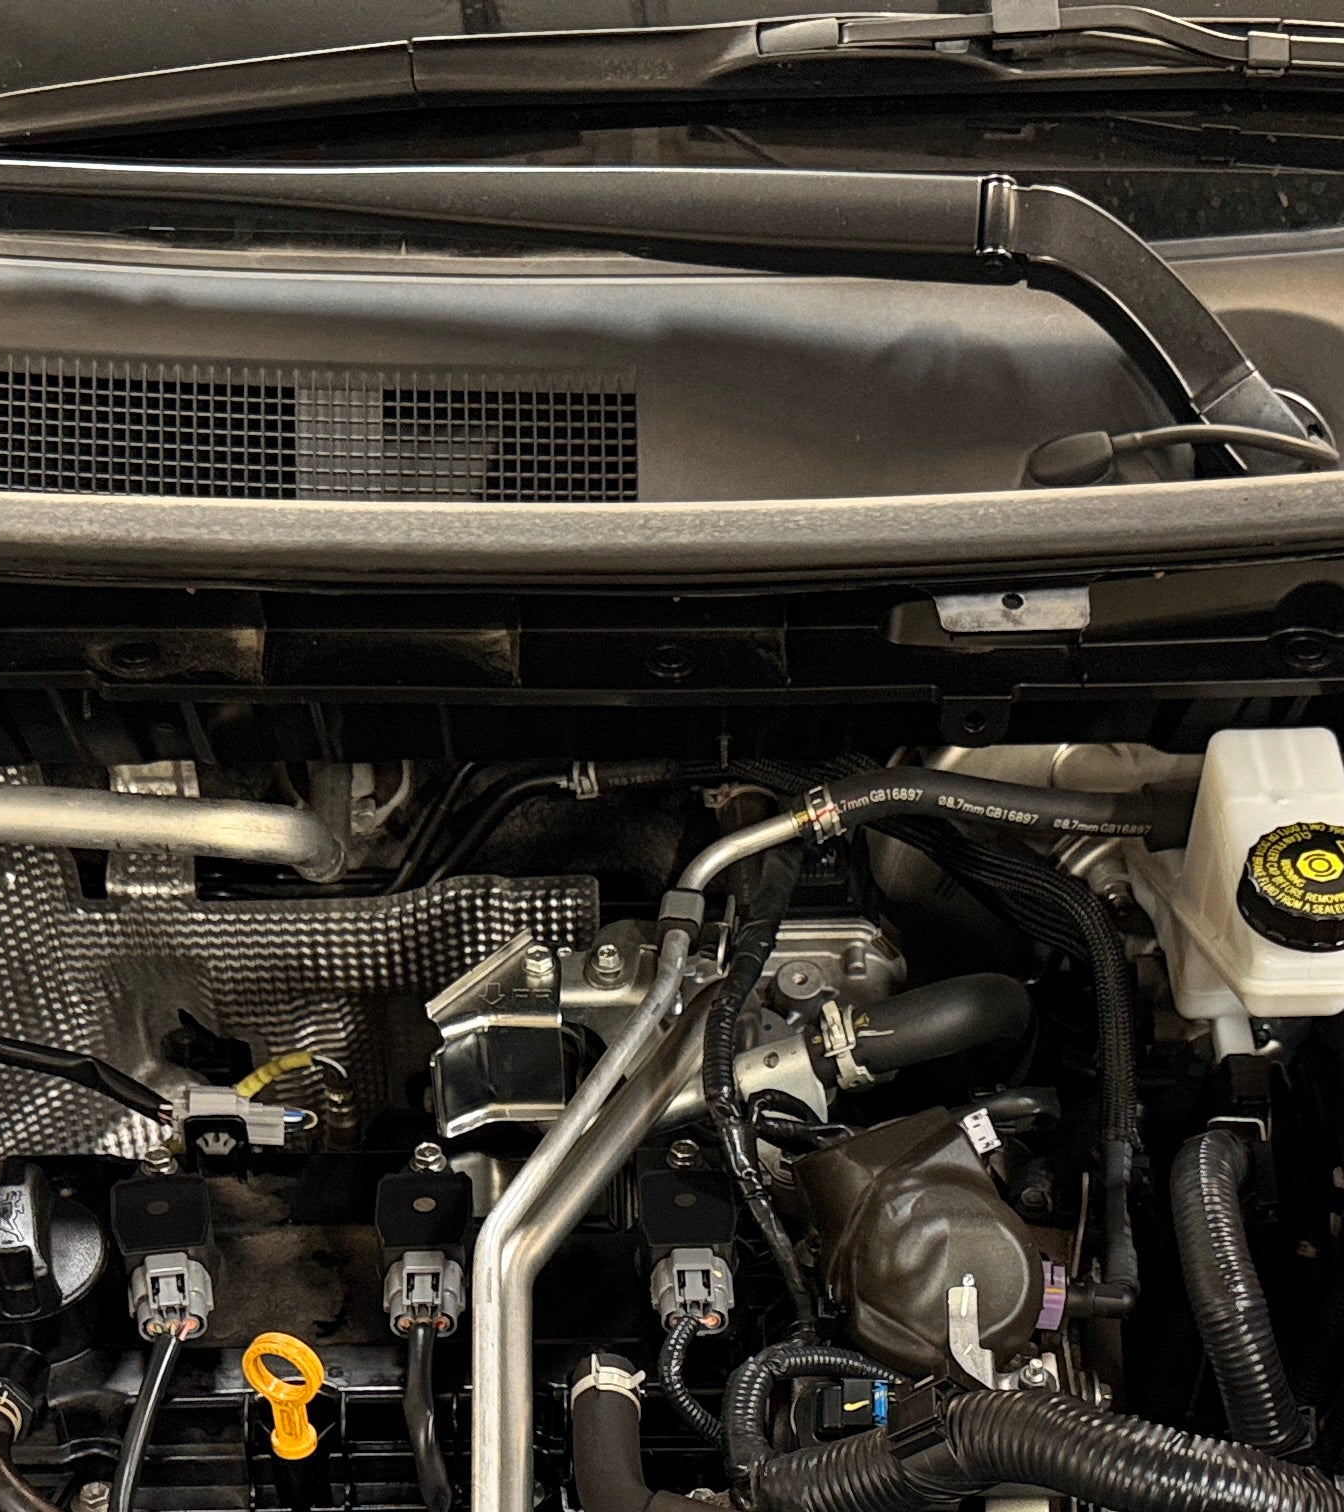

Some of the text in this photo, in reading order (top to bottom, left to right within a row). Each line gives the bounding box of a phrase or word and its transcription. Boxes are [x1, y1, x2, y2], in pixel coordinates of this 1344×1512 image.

[869, 787, 924, 803] GB16897
[985, 805, 1040, 825] GB16897
[1275, 892, 1303, 910] FROM
[1302, 902, 1311, 913] A
